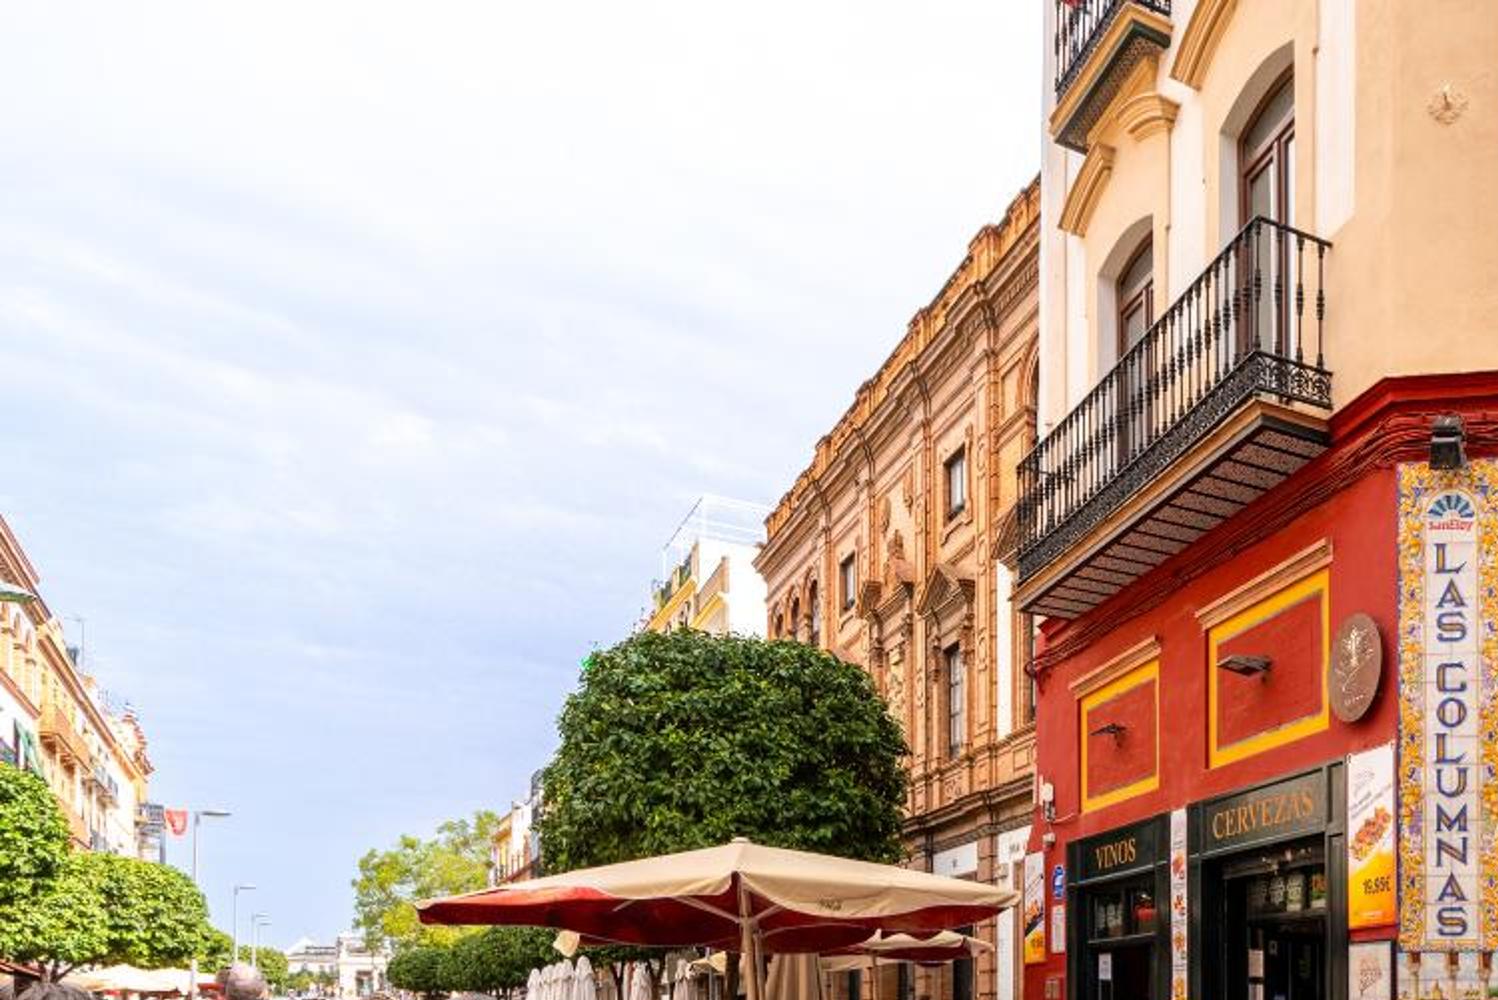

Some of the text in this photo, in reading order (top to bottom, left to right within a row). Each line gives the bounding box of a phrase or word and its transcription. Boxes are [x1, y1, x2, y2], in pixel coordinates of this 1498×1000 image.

[1434, 543, 1469, 937] LAS COLUMNAS
[1211, 787, 1314, 840] CERVEZAS
[1095, 838, 1136, 870] VINOS
